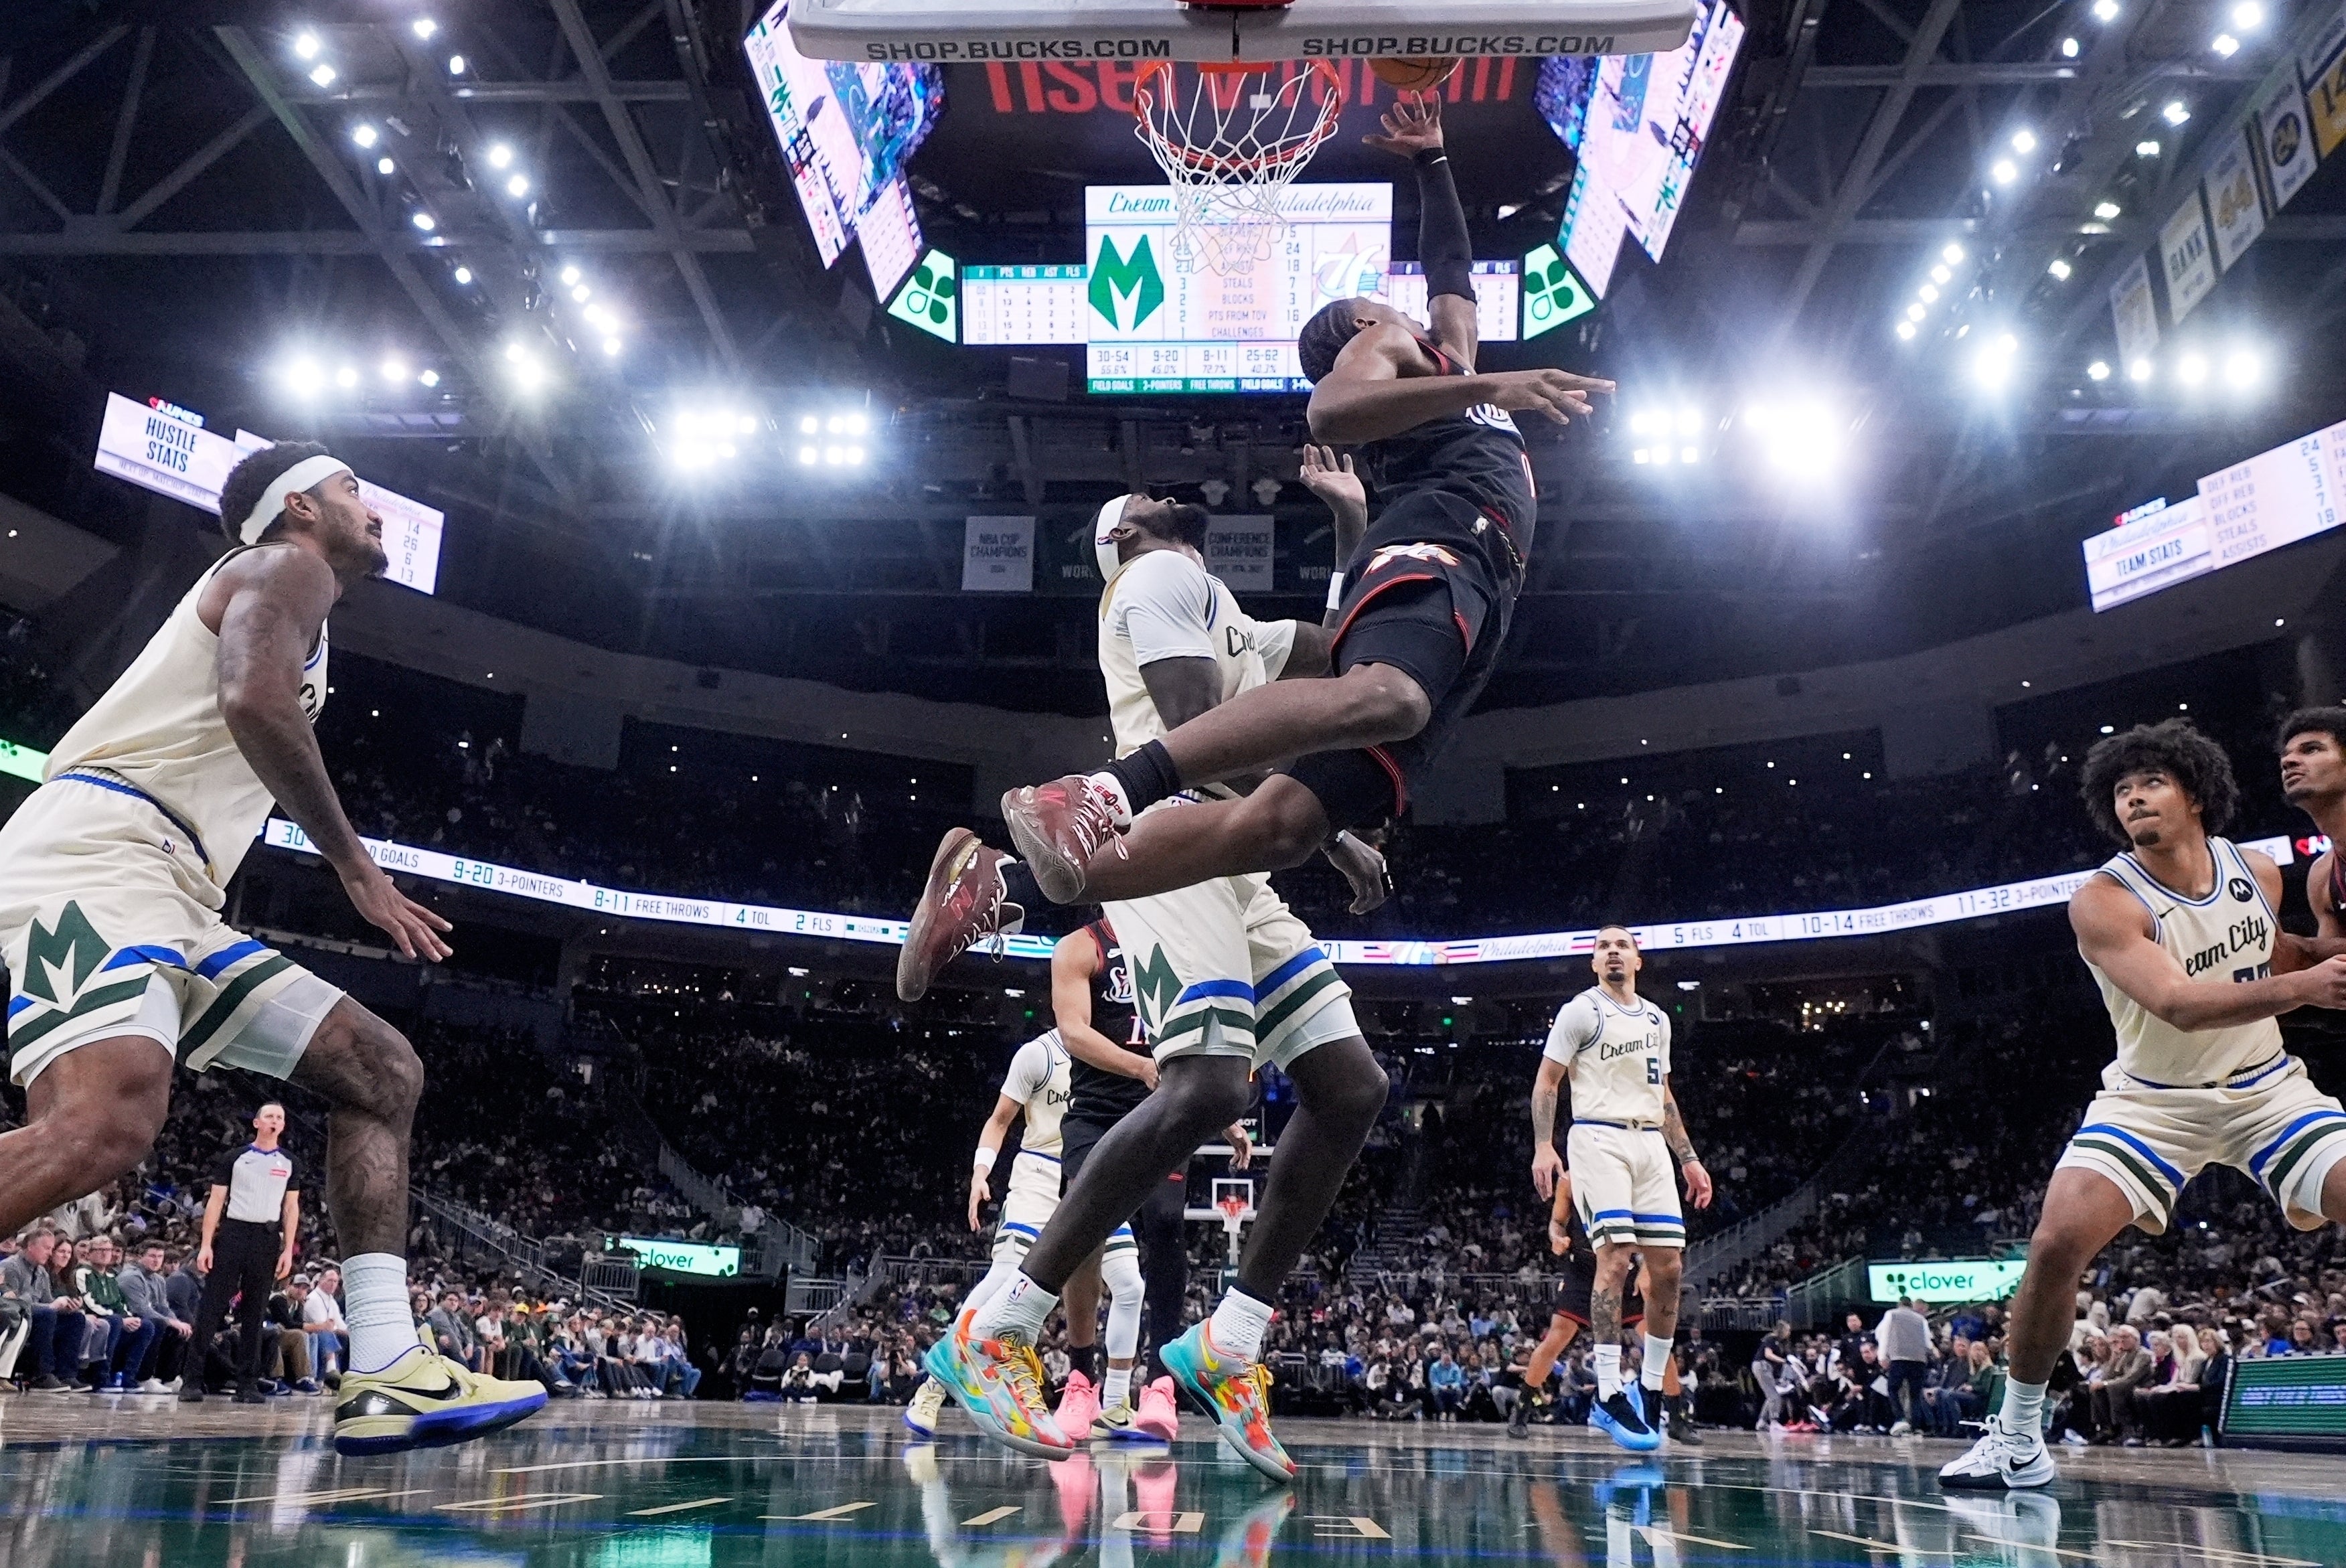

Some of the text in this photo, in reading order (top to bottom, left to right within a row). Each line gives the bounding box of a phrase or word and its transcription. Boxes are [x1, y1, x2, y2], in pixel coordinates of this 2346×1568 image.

[867, 39, 1170, 60] SHOP.BUCKS.COM
[1303, 35, 1615, 56] SHOP.BUCKS.COM
[1109, 192, 1172, 213] Cream
[1286, 242, 1300, 254] 24
[1287, 259, 1300, 271] 18
[1180, 277, 1186, 289] 3
[1223, 277, 1253, 289] STEALS
[1289, 277, 1296, 289] 7
[1180, 294, 1186, 305] 2
[1222, 294, 1254, 305] BLOCKS
[1289, 293, 1296, 305] 3
[1180, 310, 1186, 322] 2
[1208, 310, 1267, 321] PTS FROM TOV
[1287, 309, 1299, 321] 16
[1212, 327, 1263, 337] CHALLENGES
[1097, 349, 1278, 362] 30-54 9-20 8-11 25-62
[146, 416, 198, 453] HUSTLE
[147, 441, 188, 472] STATS
[407, 520, 420, 535] 14
[2222, 534, 2268, 559] ASSISTS
[381, 847, 418, 868] GOALS
[453, 860, 563, 898] 9-20 3-POINTERS
[594, 890, 710, 919] 8-11 FREE THROWS
[1958, 888, 2011, 915] 11-32
[736, 908, 770, 926] 4 TOL
[796, 915, 832, 932] 2 FLS
[1801, 905, 1935, 935] 10-14 FREE THROWS
[1675, 925, 1713, 943] 5 FLS
[1732, 921, 1770, 939] 4 TOL
[2229, 915, 2268, 952] City
[1478, 936, 1568, 960] Philadelphia
[1600, 1040, 1644, 1061] Cream
[639, 1248, 694, 1269] clover
[1909, 1271, 1975, 1291] clover
